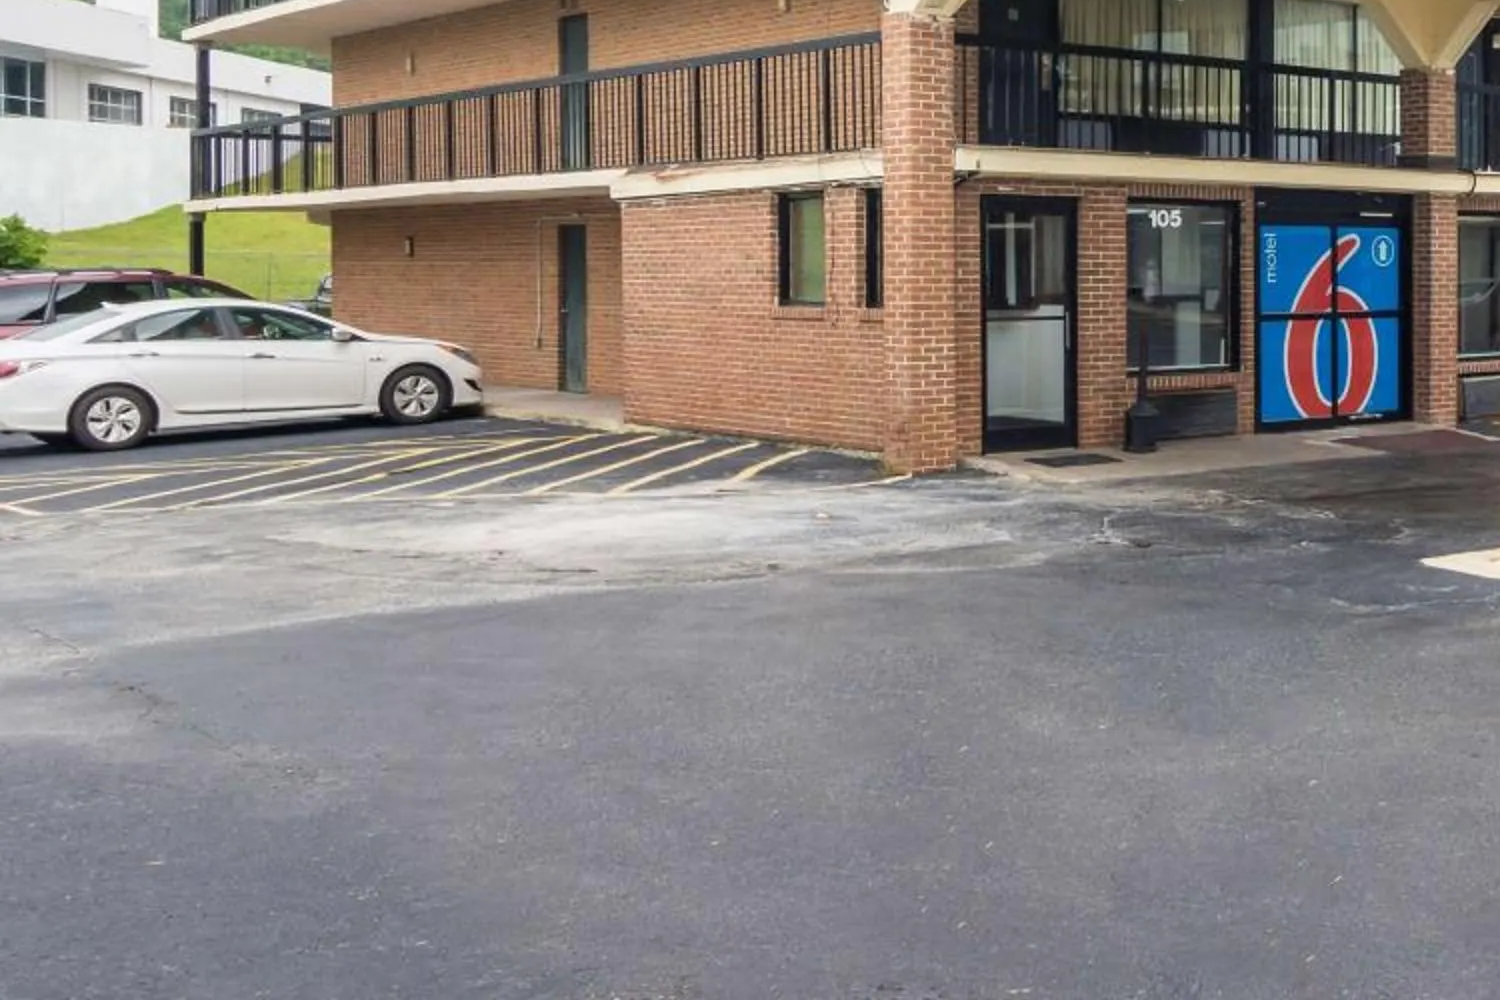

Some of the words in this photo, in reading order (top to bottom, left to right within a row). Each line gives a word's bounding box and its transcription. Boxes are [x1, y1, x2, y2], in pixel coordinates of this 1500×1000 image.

[1149, 209, 1182, 228] 105
[1264, 233, 1277, 283] motel
[1284, 233, 1379, 418] 6
